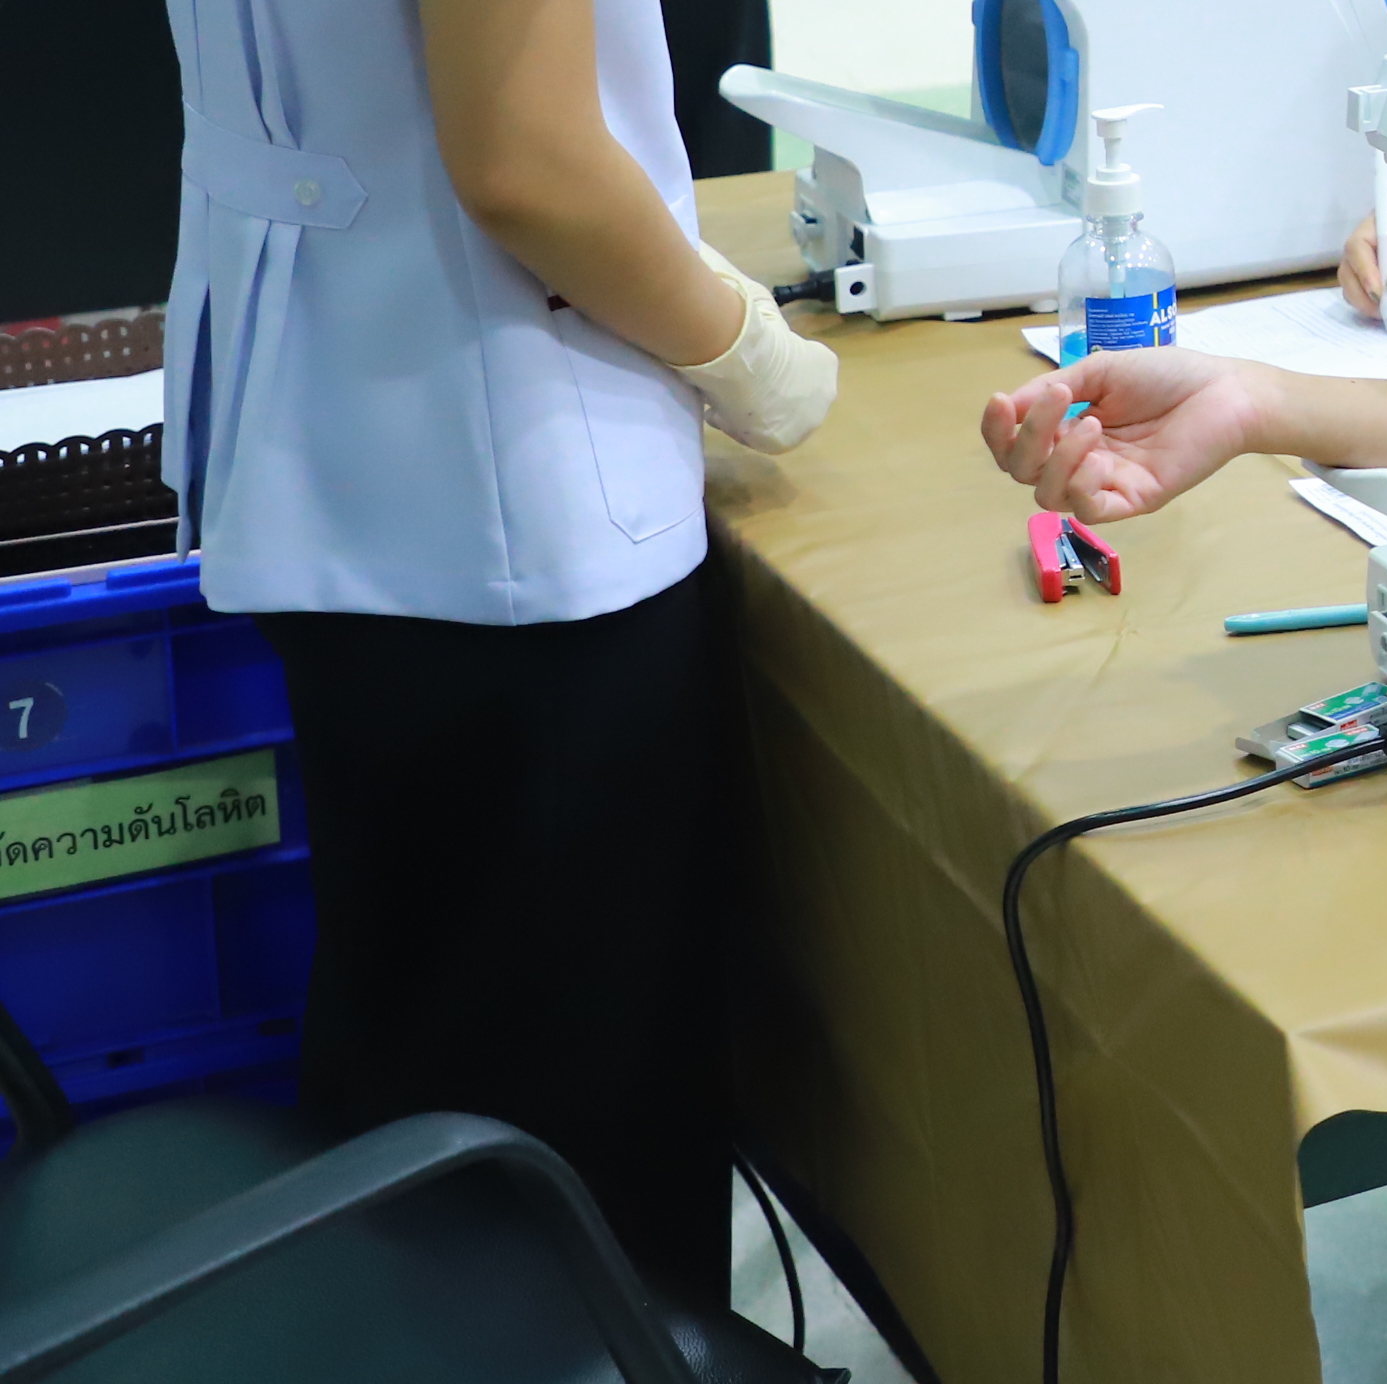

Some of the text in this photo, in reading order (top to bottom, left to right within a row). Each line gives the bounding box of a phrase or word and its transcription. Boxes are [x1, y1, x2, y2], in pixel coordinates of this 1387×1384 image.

[8, 696, 35, 740] 7
[0, 787, 267, 867] ดความดันโลหิต
